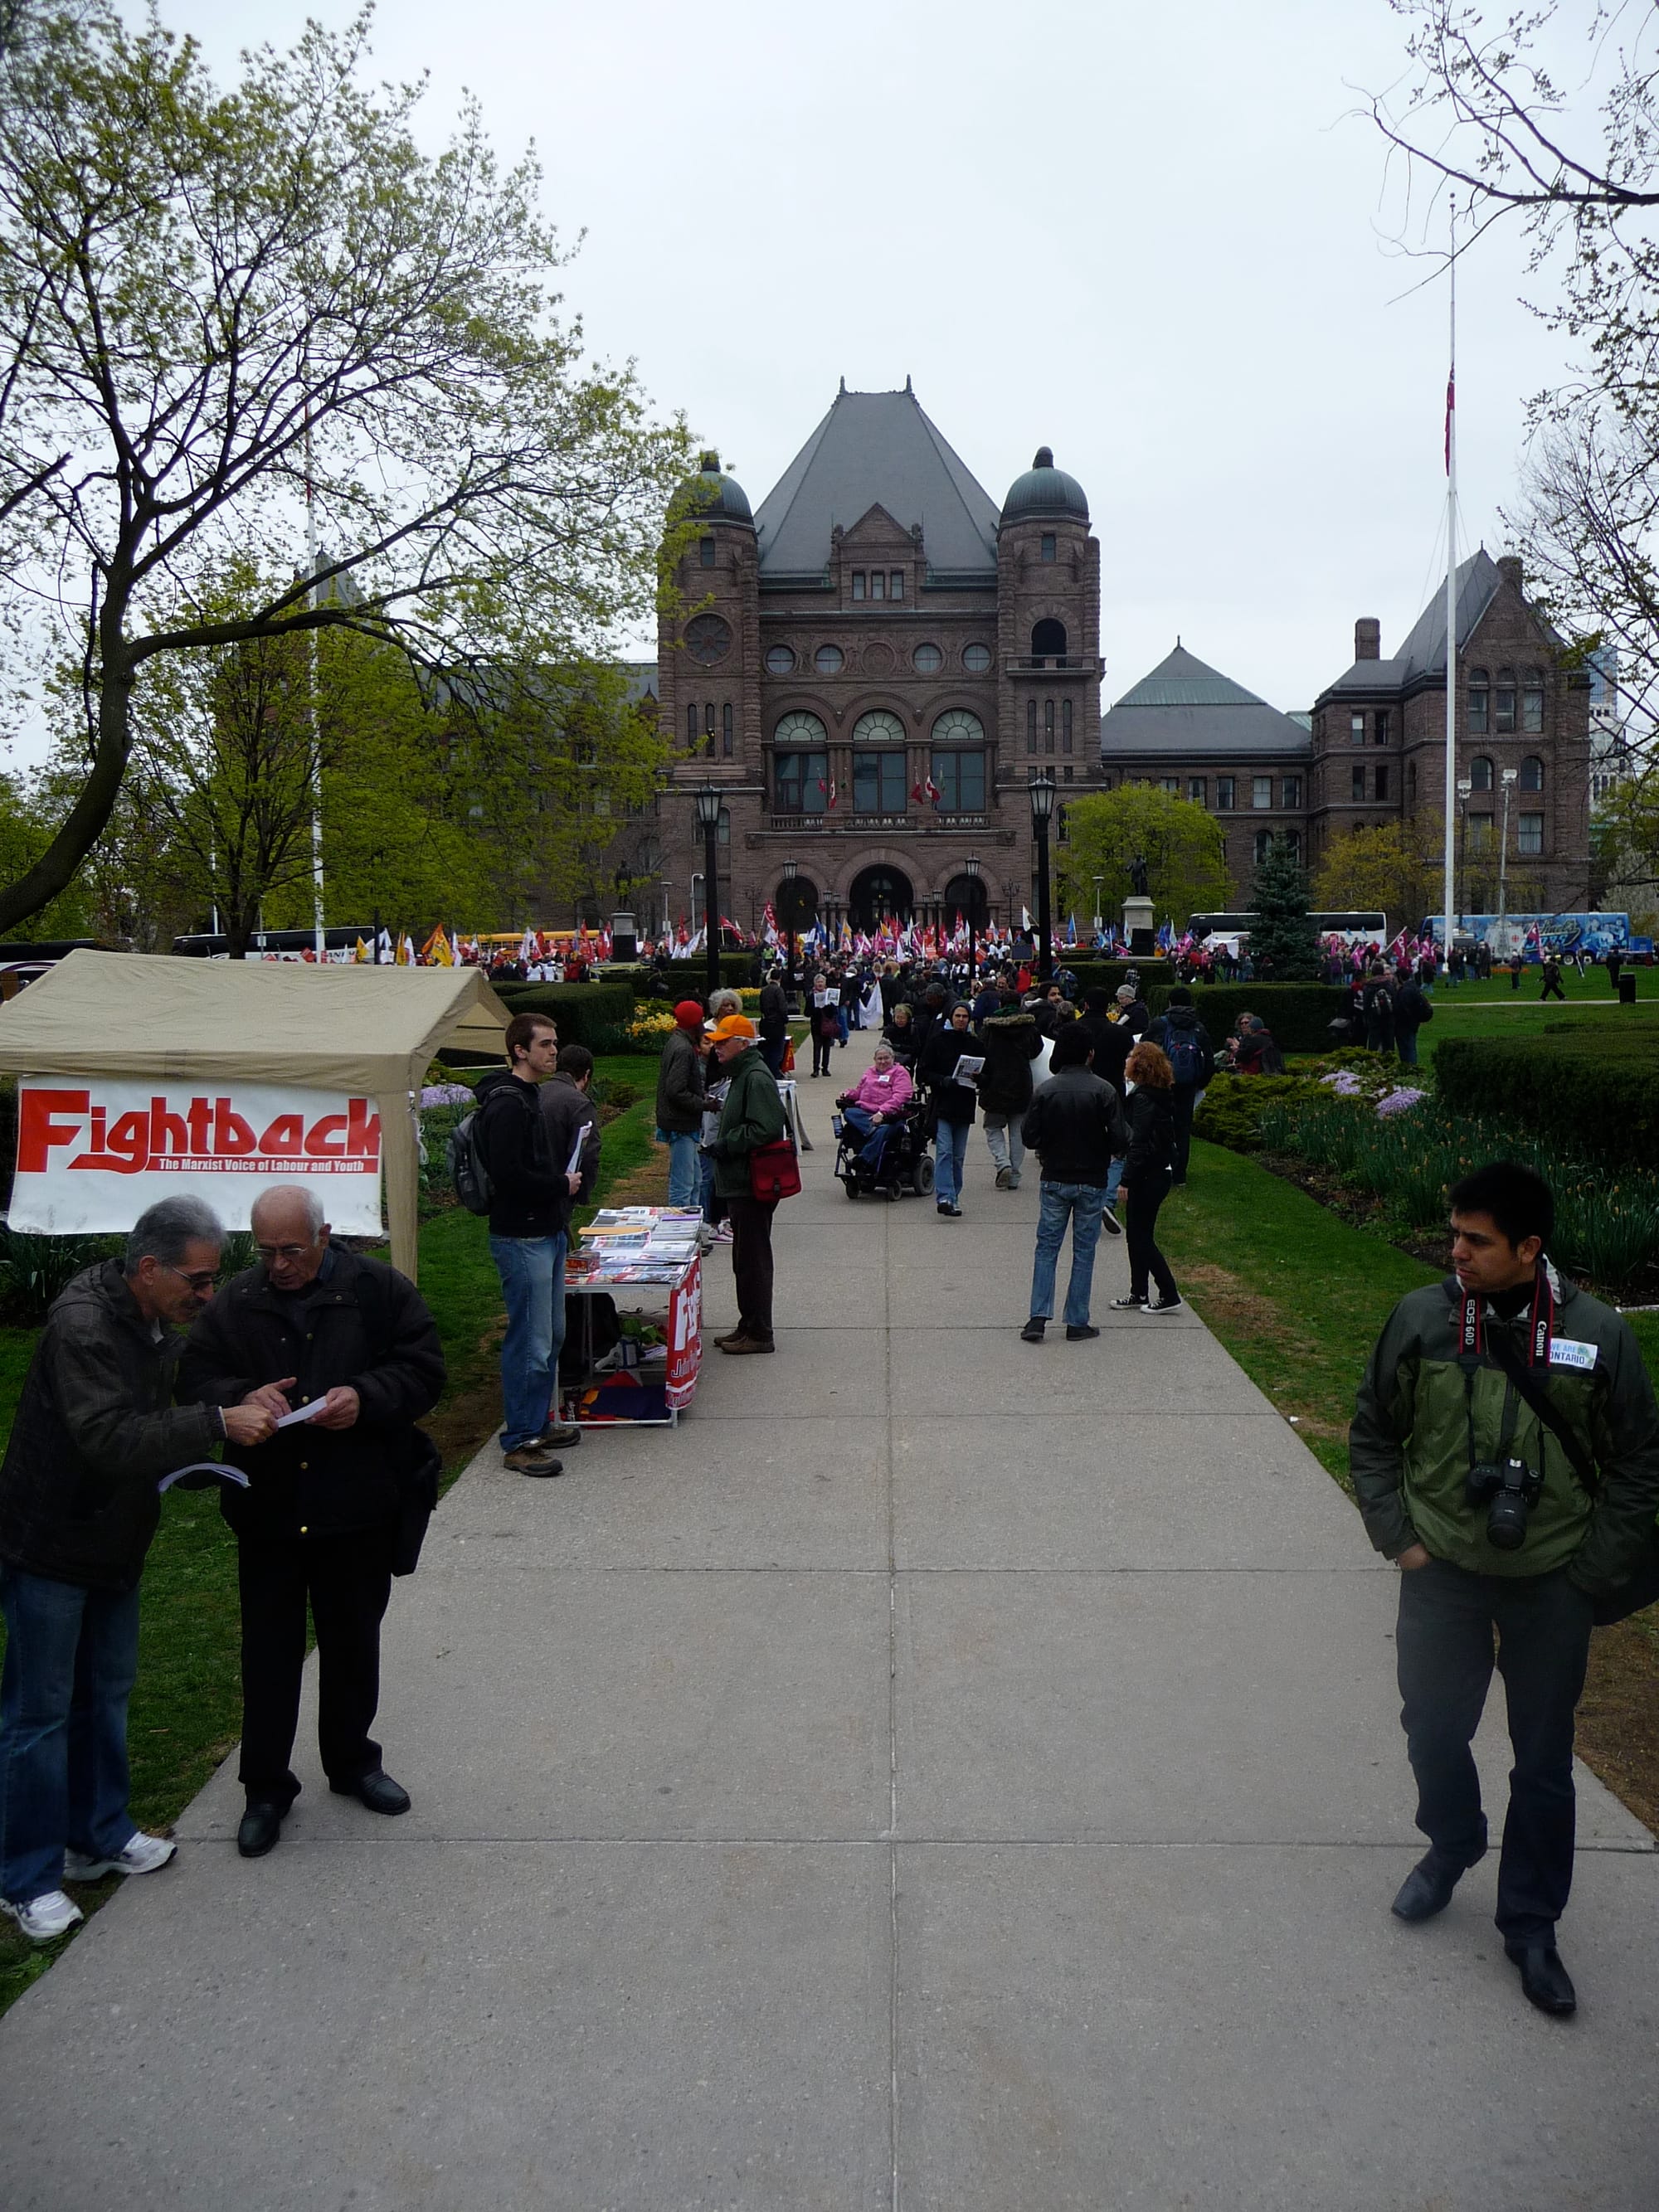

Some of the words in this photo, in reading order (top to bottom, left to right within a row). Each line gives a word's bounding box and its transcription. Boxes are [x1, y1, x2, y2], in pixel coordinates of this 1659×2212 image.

[17, 1088, 381, 1174] Fightback
[159, 1158, 179, 1170] The
[181, 1158, 222, 1171] Marxist
[225, 1159, 255, 1171] Voice
[258, 1159, 270, 1171] of
[270, 1159, 309, 1172] Labour
[311, 1160, 332, 1172] and
[334, 1160, 364, 1173] Youth
[1466, 1299, 1476, 1325] EOS
[1465, 1326, 1475, 1345] 60D
[1535, 1320, 1547, 1357] Canon
[1563, 1344, 1576, 1354] ARE
